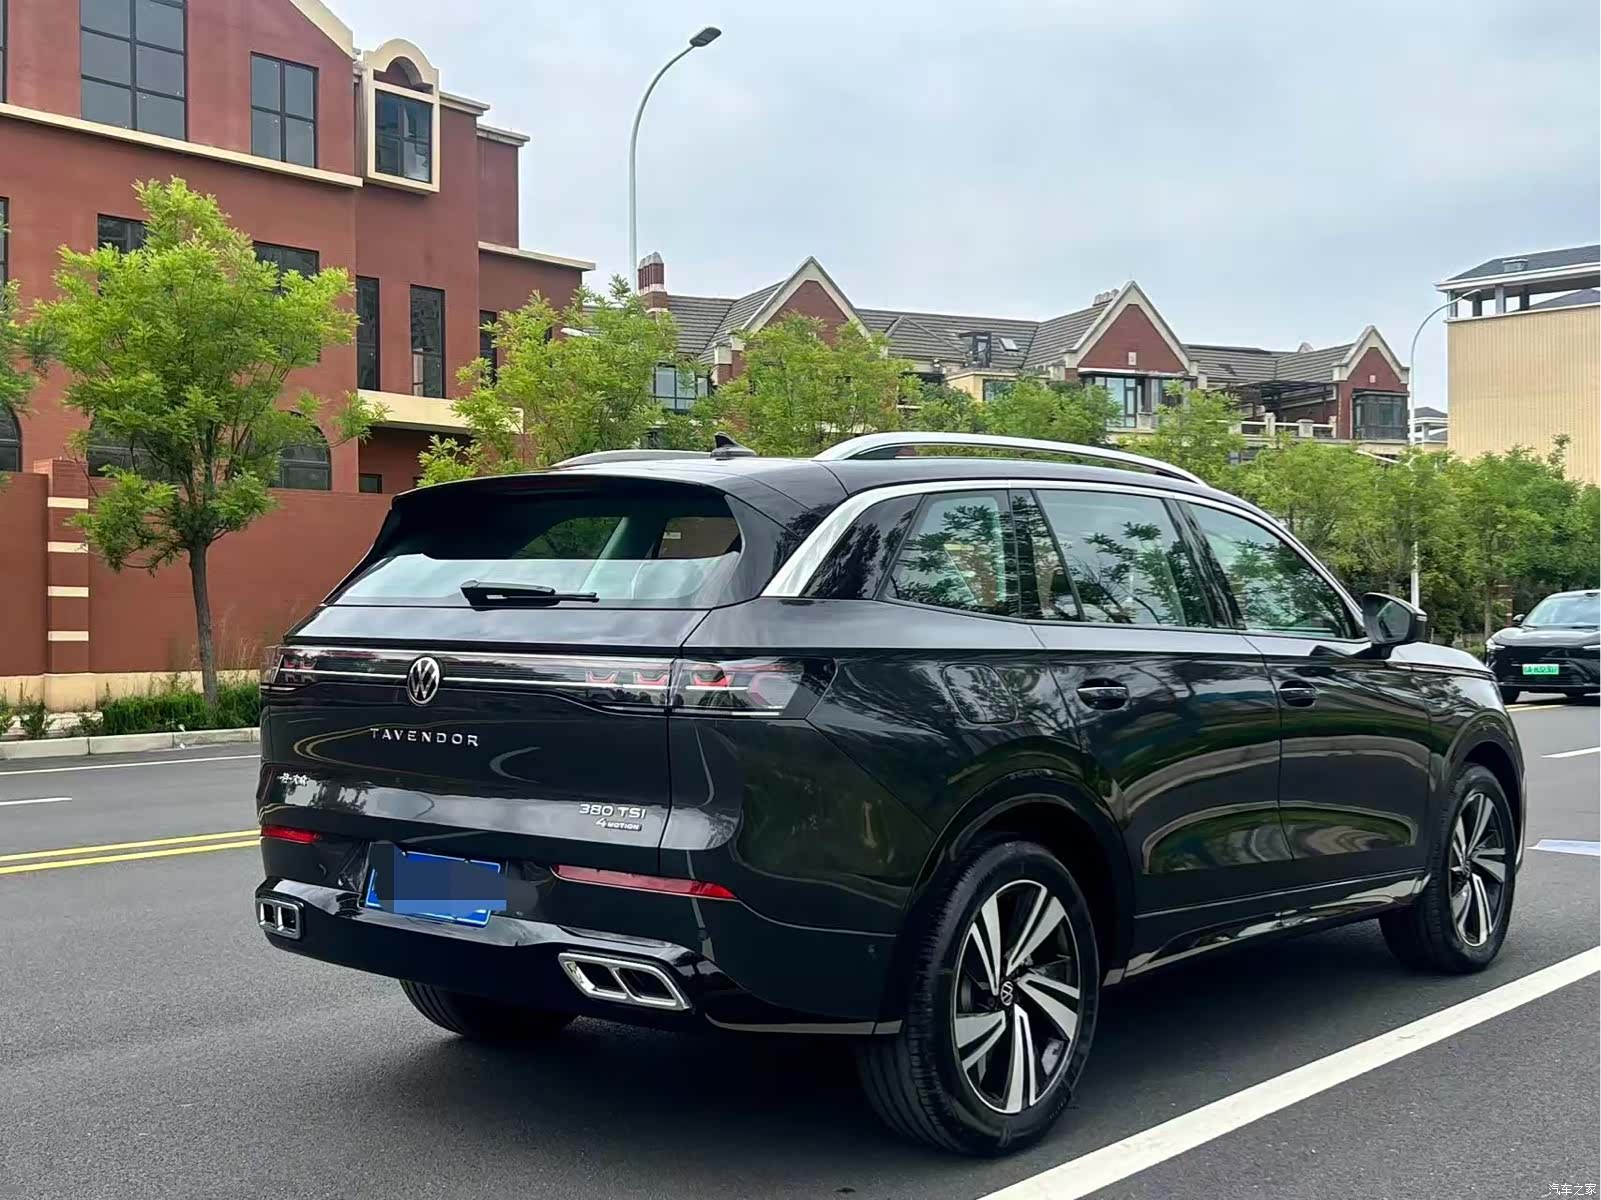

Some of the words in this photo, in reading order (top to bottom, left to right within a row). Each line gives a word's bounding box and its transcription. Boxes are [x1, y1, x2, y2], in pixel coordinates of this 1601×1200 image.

[369, 727, 479, 748] TAVENDOR
[578, 803, 615, 817] 380
[617, 806, 647, 819] TSI
